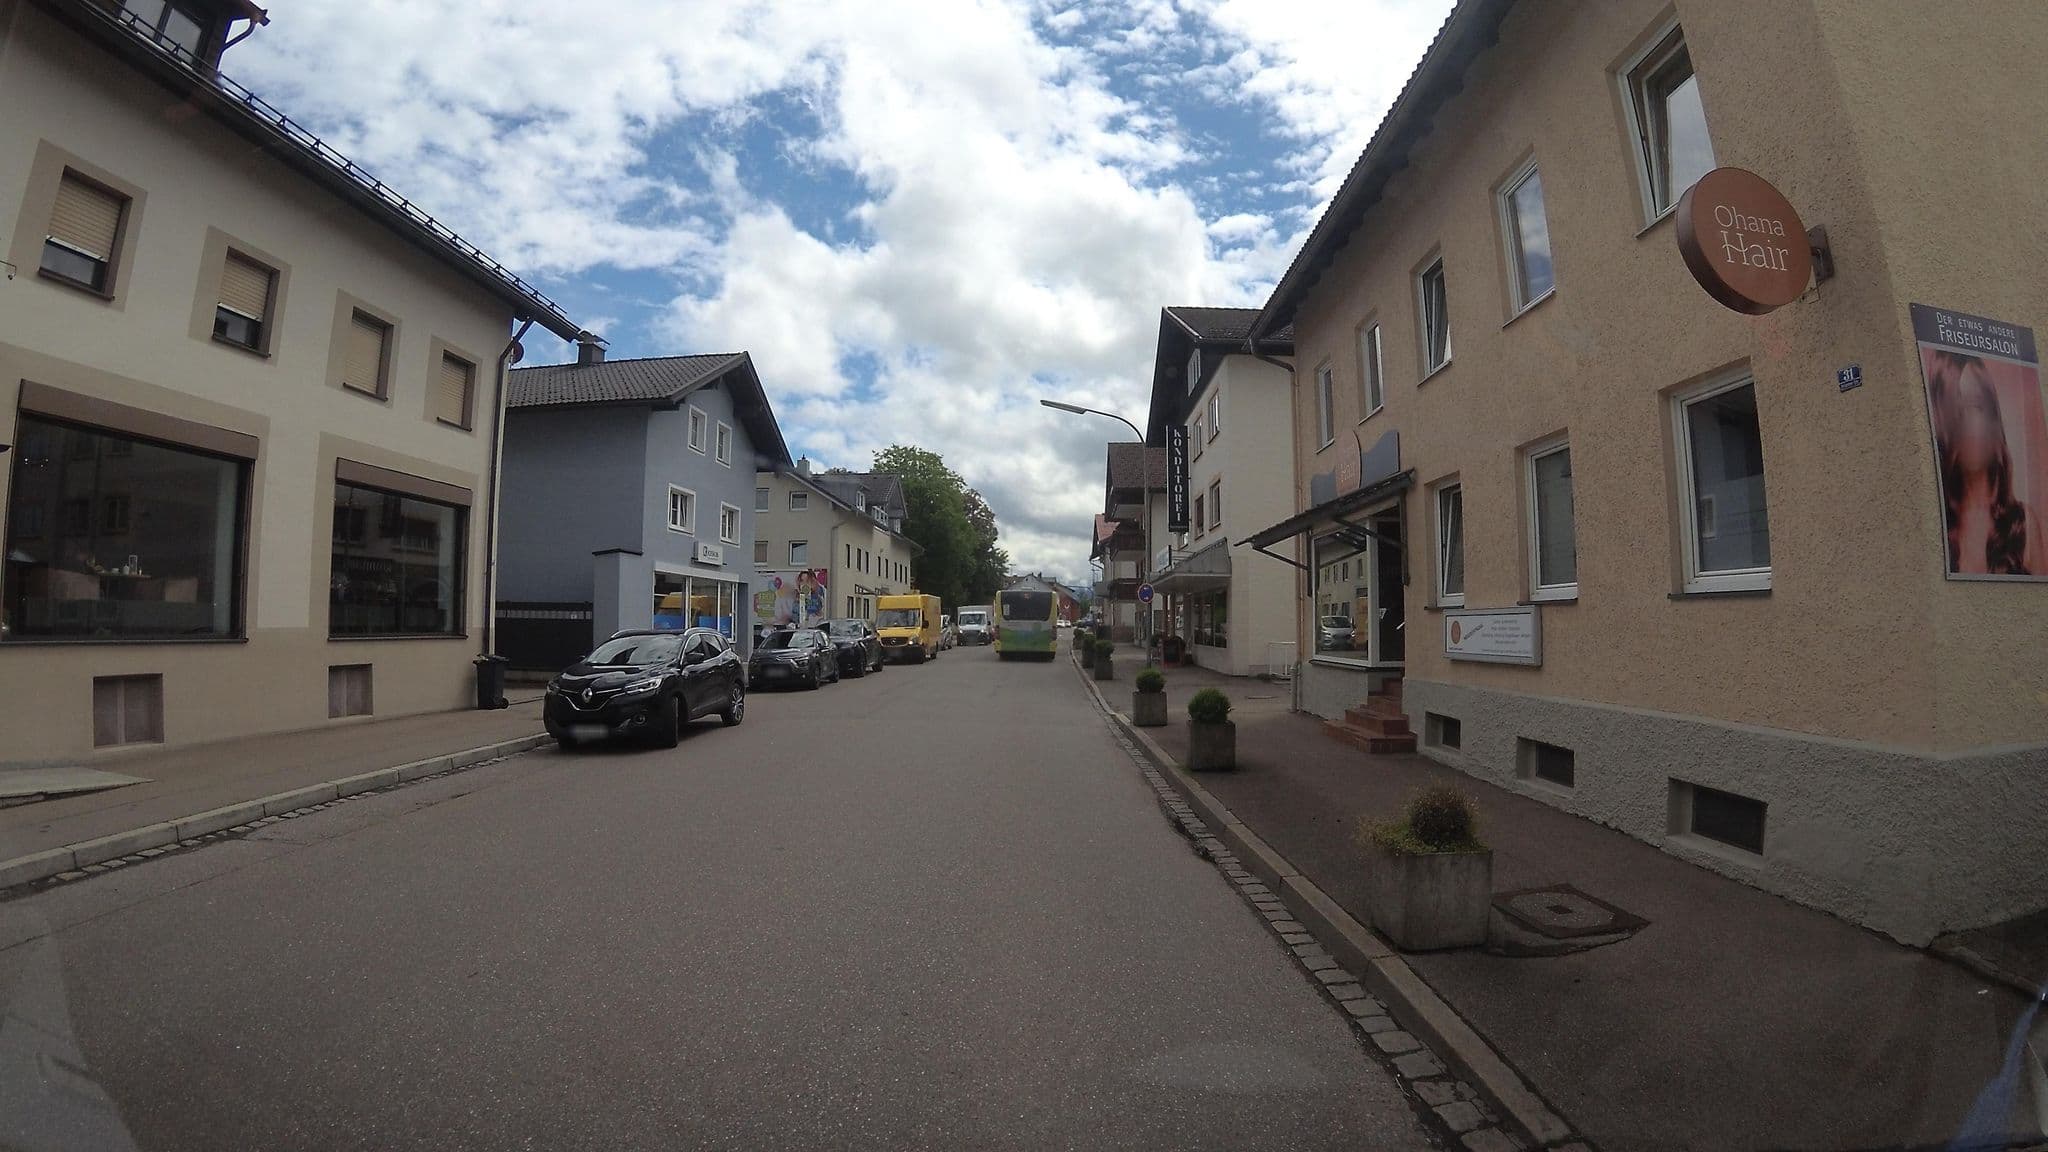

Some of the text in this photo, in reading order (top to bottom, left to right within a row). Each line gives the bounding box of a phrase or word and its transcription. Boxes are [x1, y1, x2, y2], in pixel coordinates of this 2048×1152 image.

[1714, 205, 1785, 237] Ohana
[1720, 231, 1789, 271] Hair
[1936, 311, 2015, 339] DER ETWAS ANDERE
[1938, 324, 2018, 355] FRISEURSALON
[1173, 428, 1183, 522] KONDITOREI
